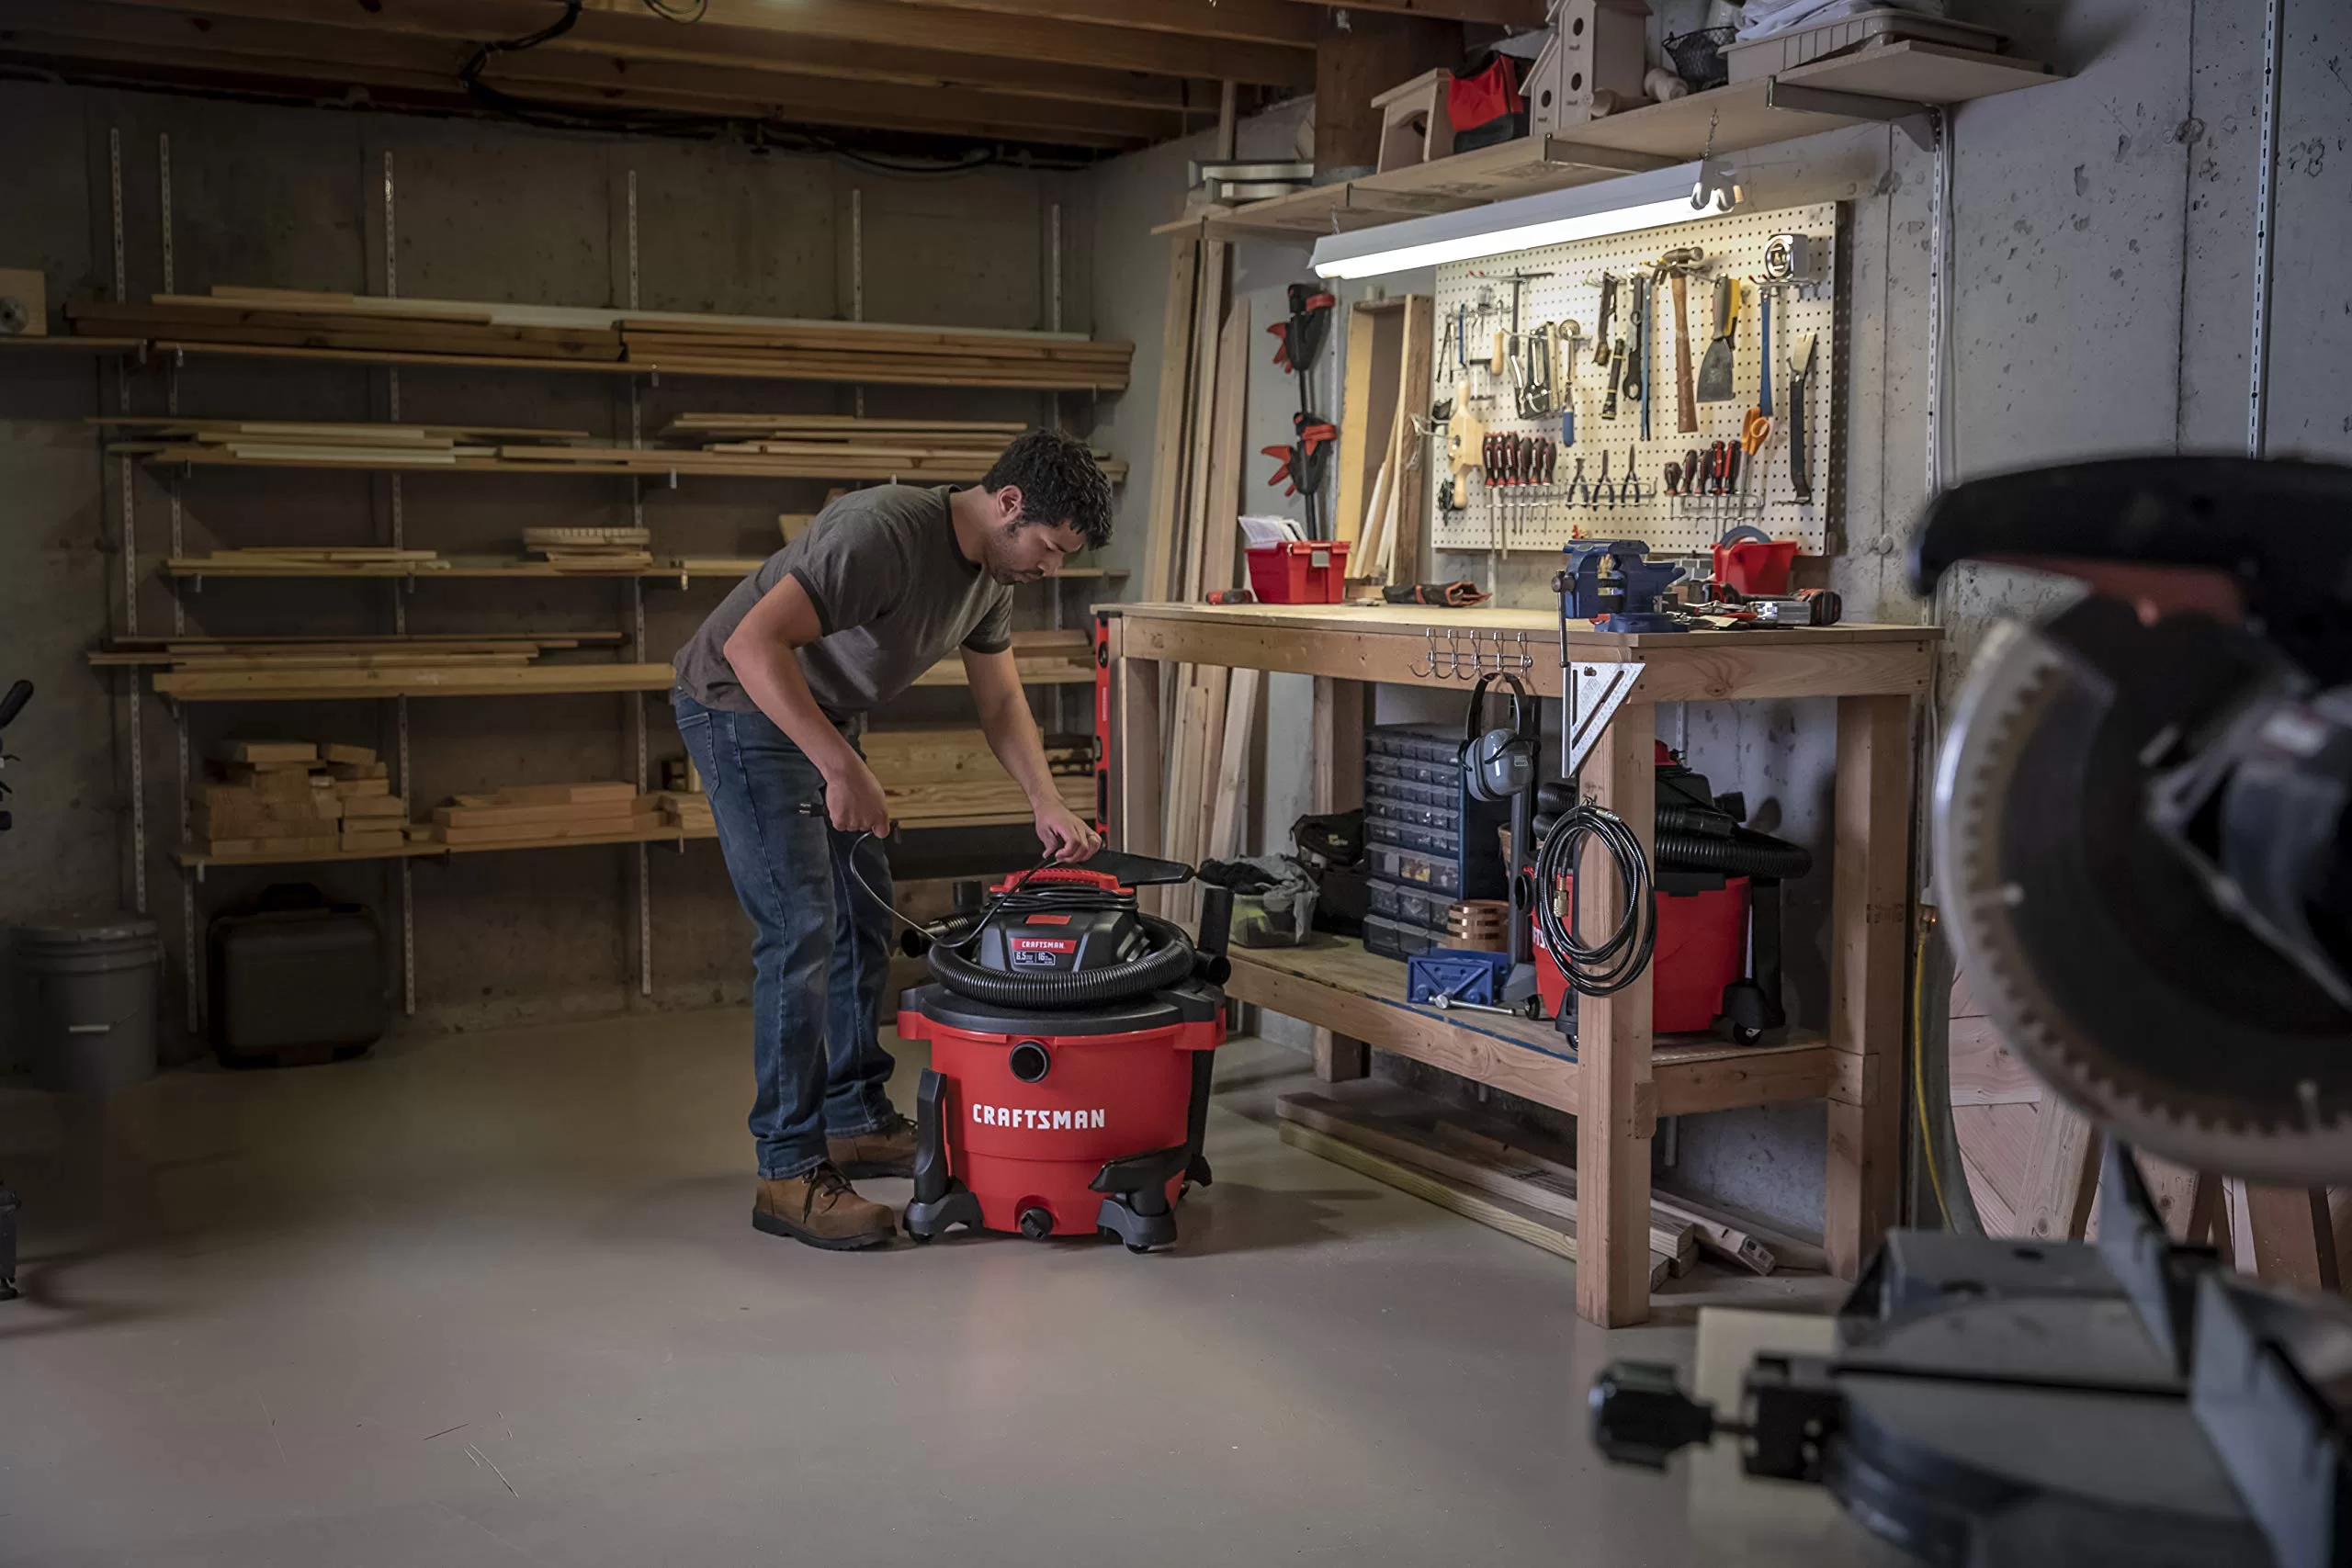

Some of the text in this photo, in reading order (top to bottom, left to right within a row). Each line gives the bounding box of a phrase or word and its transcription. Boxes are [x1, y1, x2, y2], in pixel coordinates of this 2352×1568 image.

[1022, 941, 1064, 949] CRAFTSMAN
[1016, 952, 1026, 960] 6.5
[1038, 952, 1046, 961] 16
[972, 1103, 1105, 1130] CRAFTSMAN
